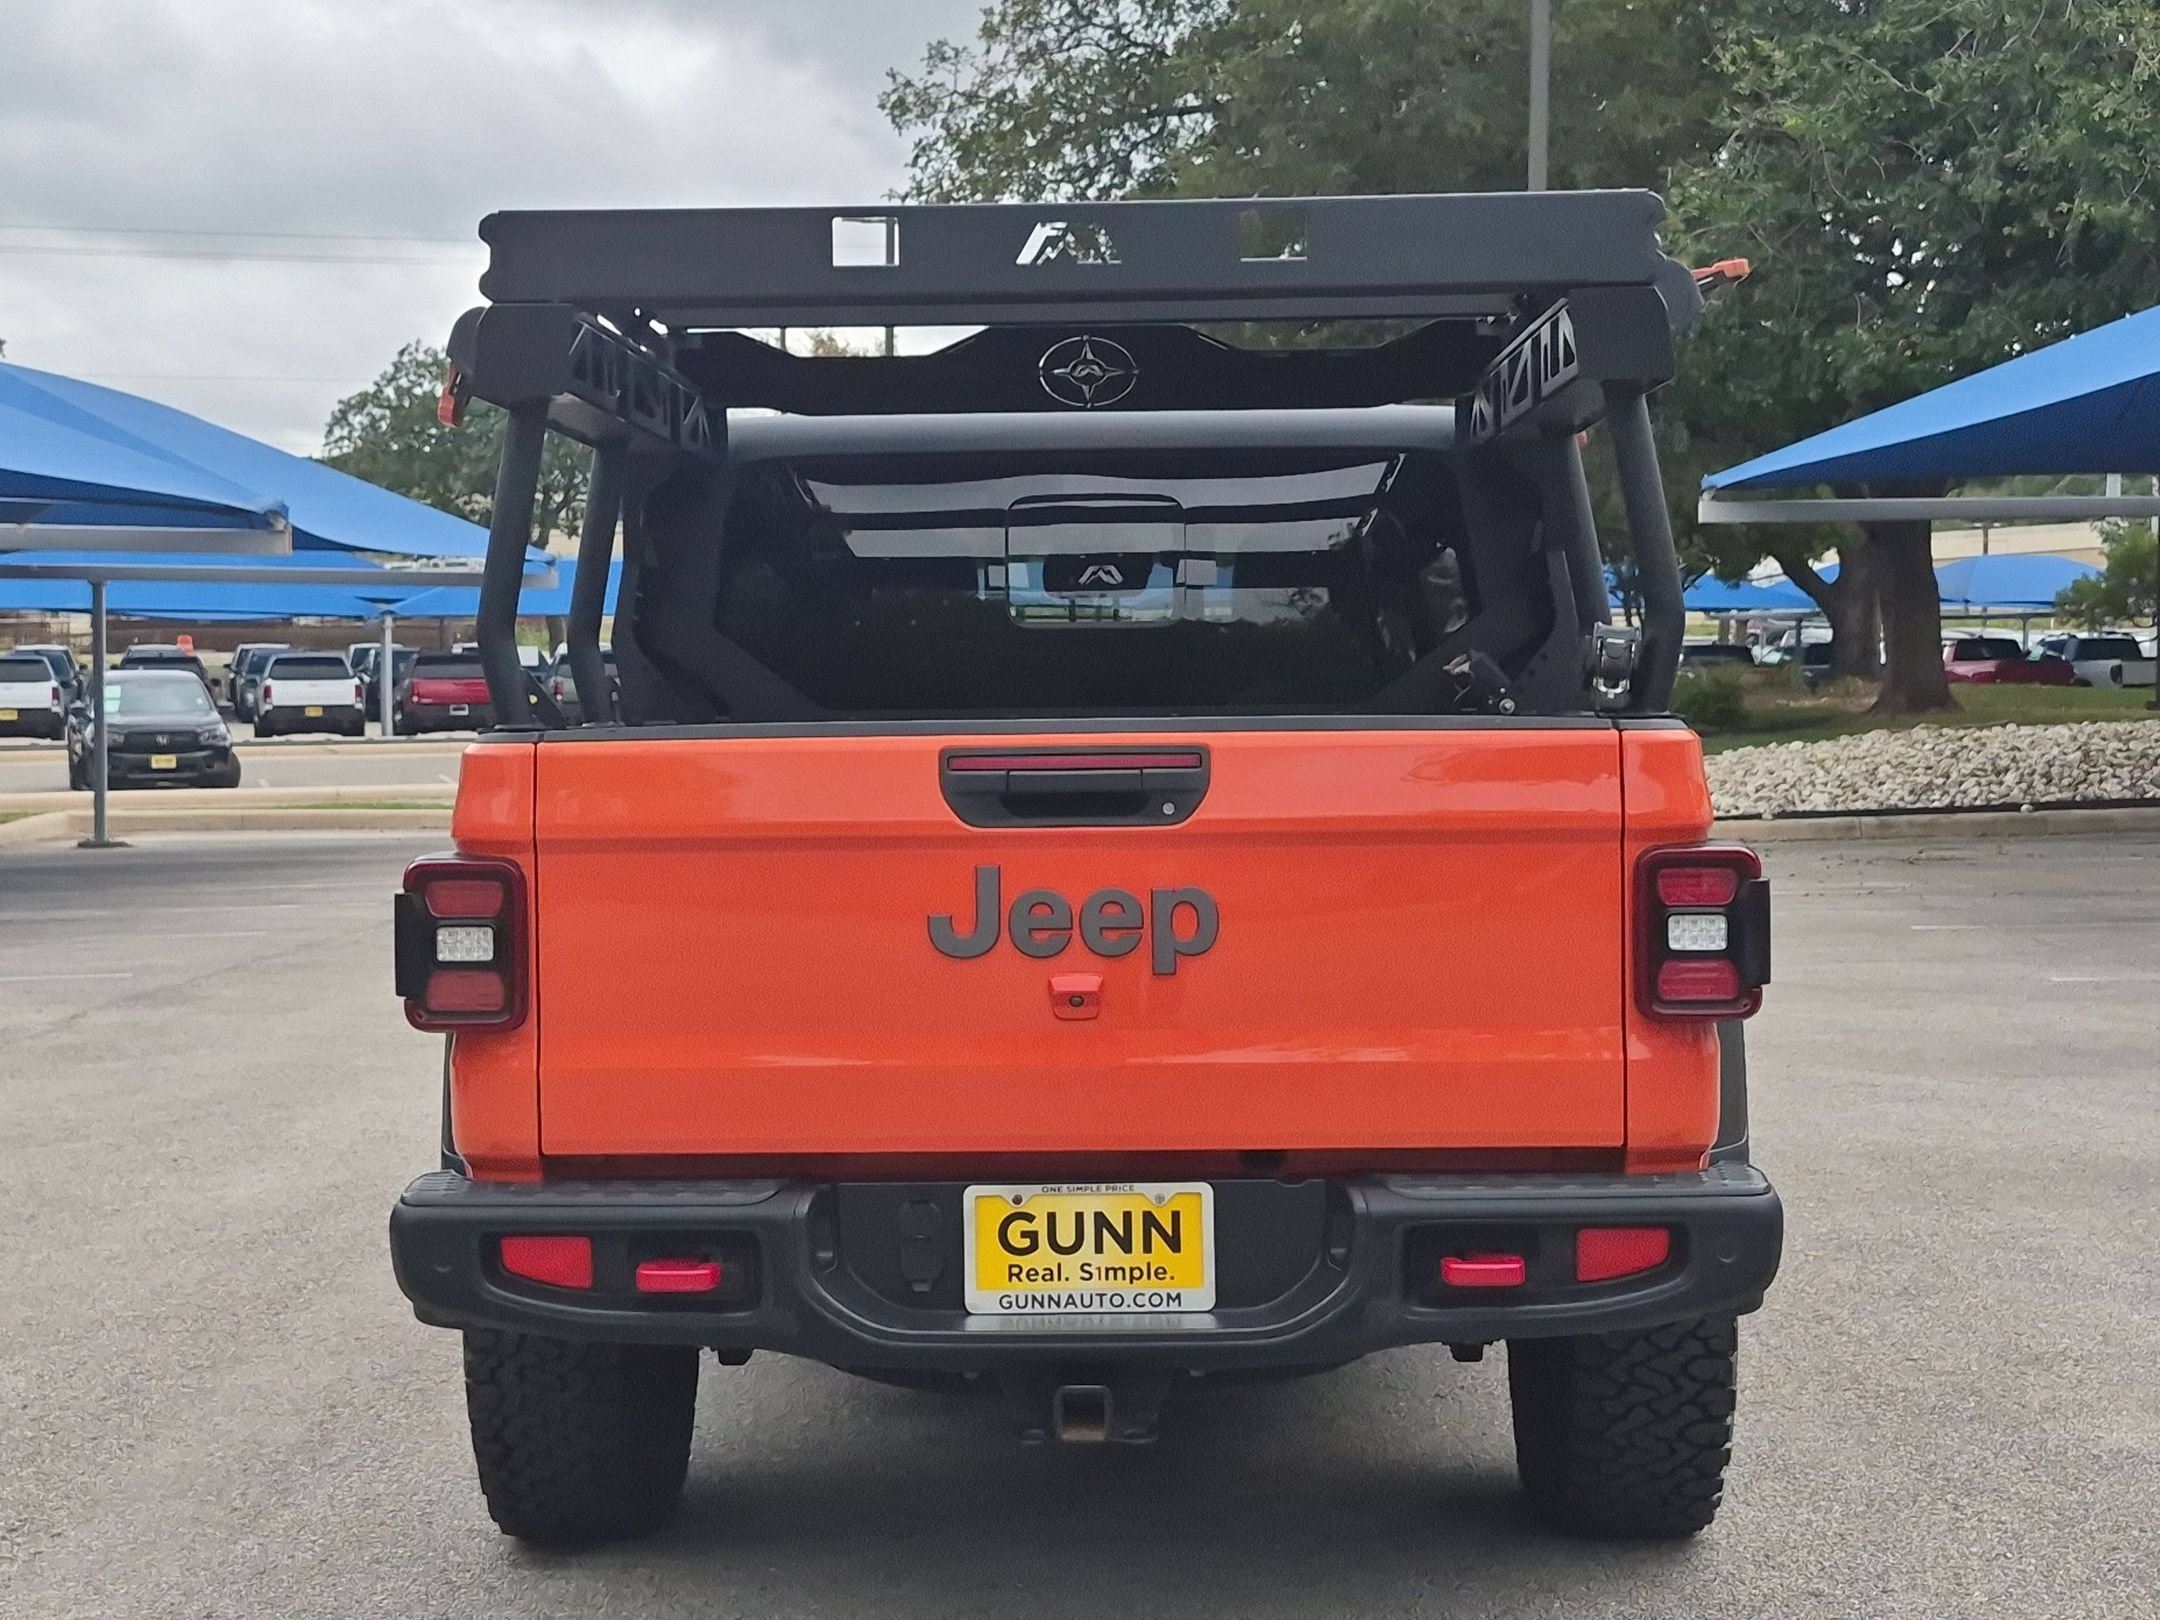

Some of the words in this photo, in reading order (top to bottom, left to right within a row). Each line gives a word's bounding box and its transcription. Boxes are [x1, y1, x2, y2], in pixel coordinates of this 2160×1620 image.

[928, 864, 1220, 976] Jeep
[1041, 1185, 1063, 1193] ONE
[1066, 1185, 1102, 1193] SIMPLE
[1105, 1184, 1135, 1192] PRICE
[997, 1210, 1182, 1257] GUNN
[1007, 1262, 1070, 1283] Real.
[998, 1292, 1182, 1310] GUNNAUTO.COM
